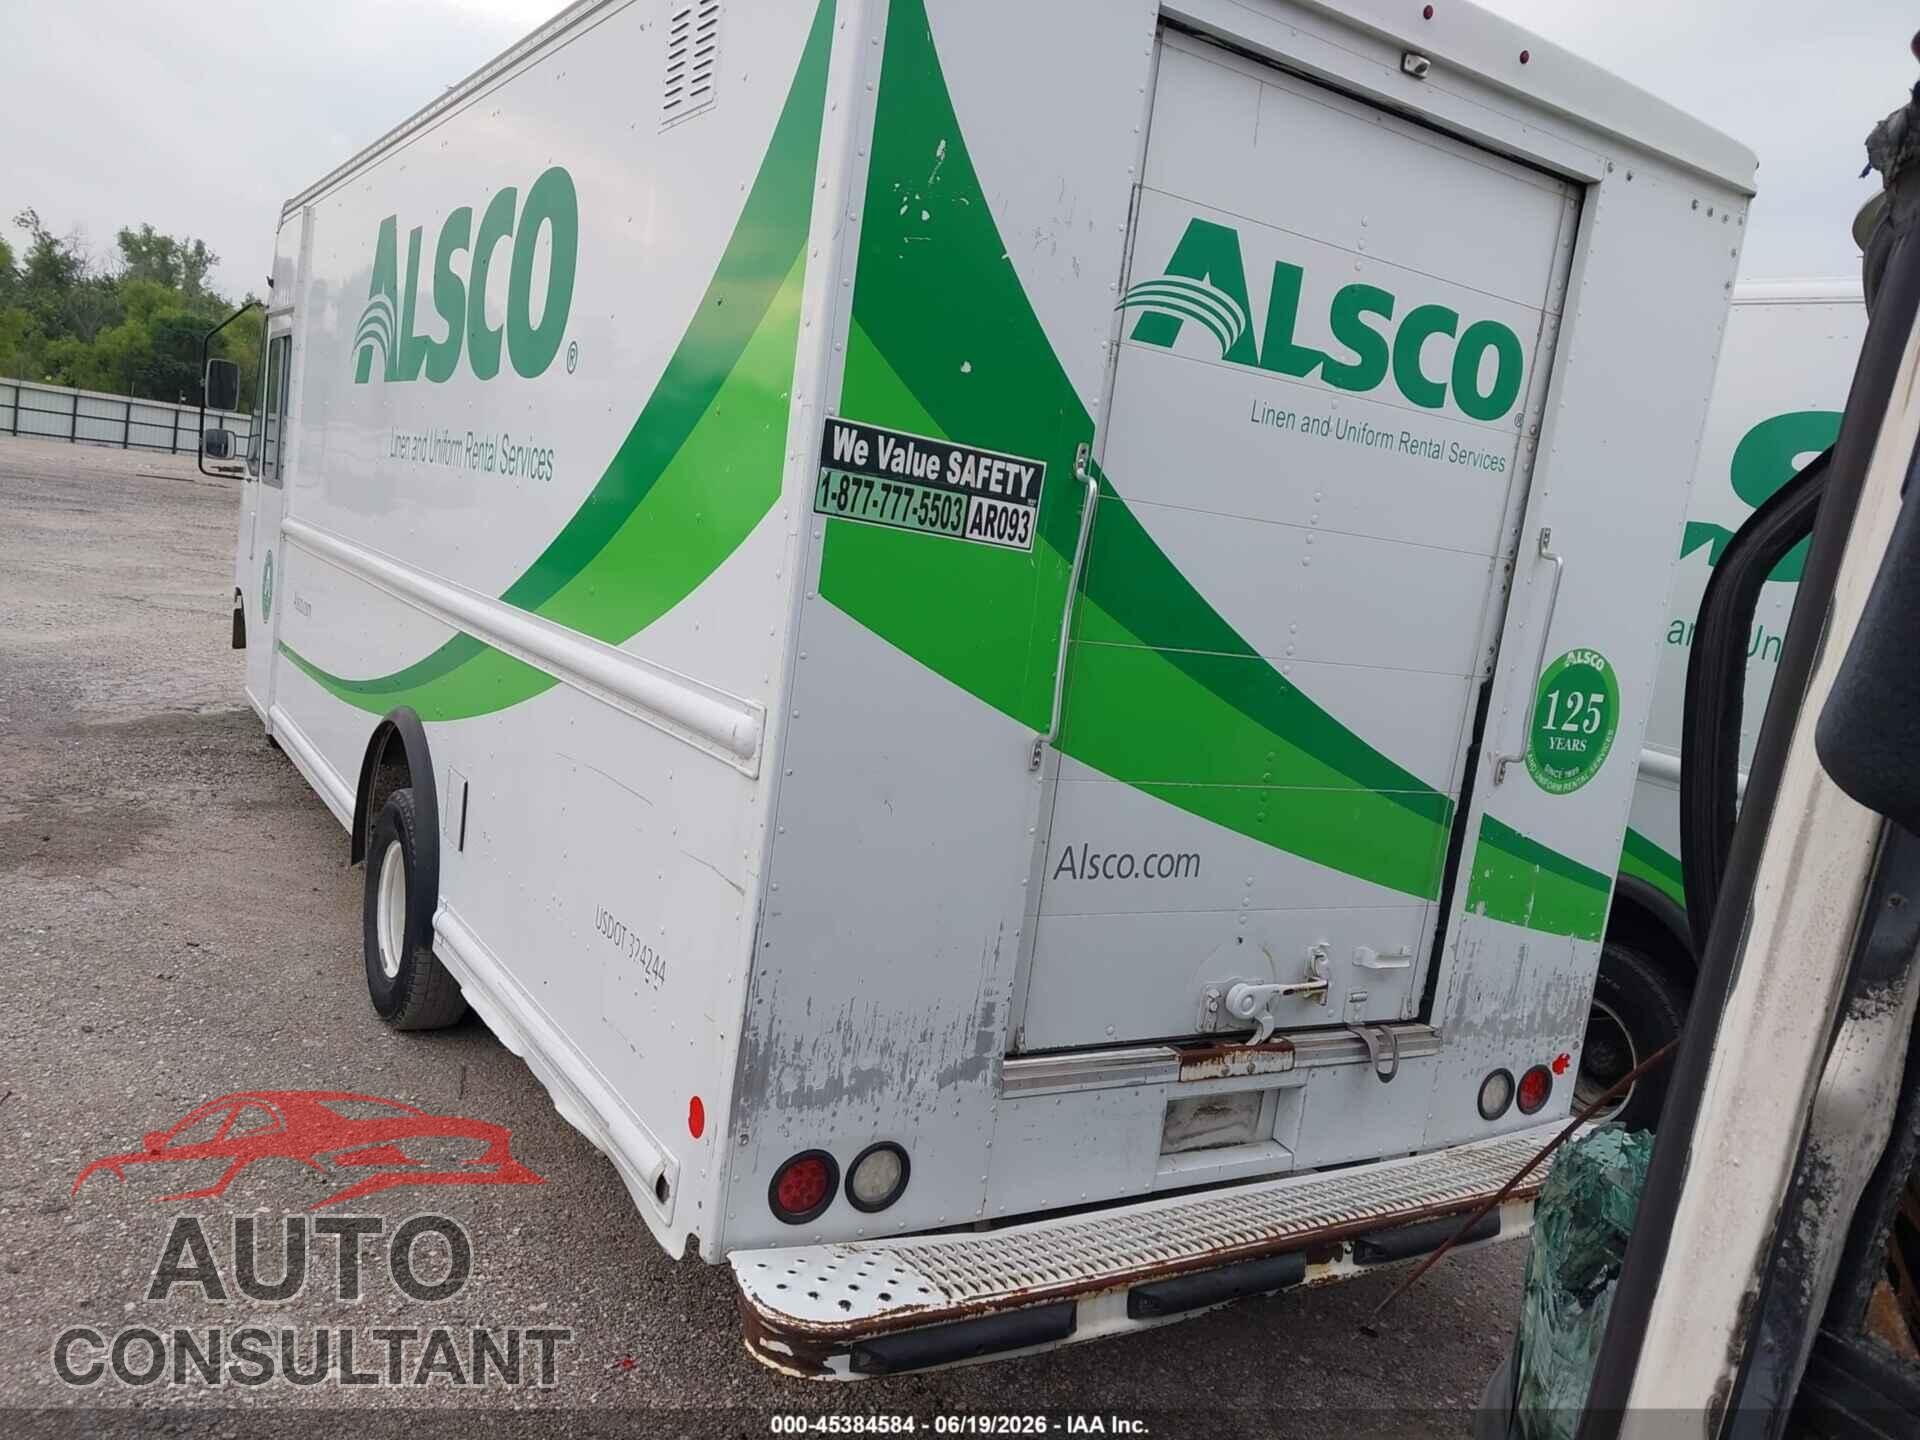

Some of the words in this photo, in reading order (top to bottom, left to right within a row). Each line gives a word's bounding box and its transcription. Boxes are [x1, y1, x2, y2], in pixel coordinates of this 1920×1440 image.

[352, 166, 579, 383] ALSCO
[1114, 217, 1524, 421] ALSCO
[390, 426, 411, 460] Linen
[412, 429, 428, 462] and
[429, 428, 463, 467] Uniform
[465, 431, 498, 473] Rental
[499, 432, 554, 482] Services
[832, 425, 870, 466] We
[877, 435, 941, 480] Value
[946, 450, 1035, 498] SAFETY
[1250, 400, 1296, 430] Linen
[1300, 415, 1331, 437] and
[1335, 417, 1394, 450] Uniform
[1399, 431, 1446, 461] Rental
[1448, 442, 1506, 473] Services
[820, 470, 963, 532] 1-877-777-5503
[968, 501, 1031, 544] AR093
[1565, 650, 1605, 672] ALSCO
[1541, 689, 1606, 734] 125
[1548, 736, 1588, 753] YEARS
[1052, 842, 1201, 881] Alsco.com
[595, 903, 628, 951] USDOT
